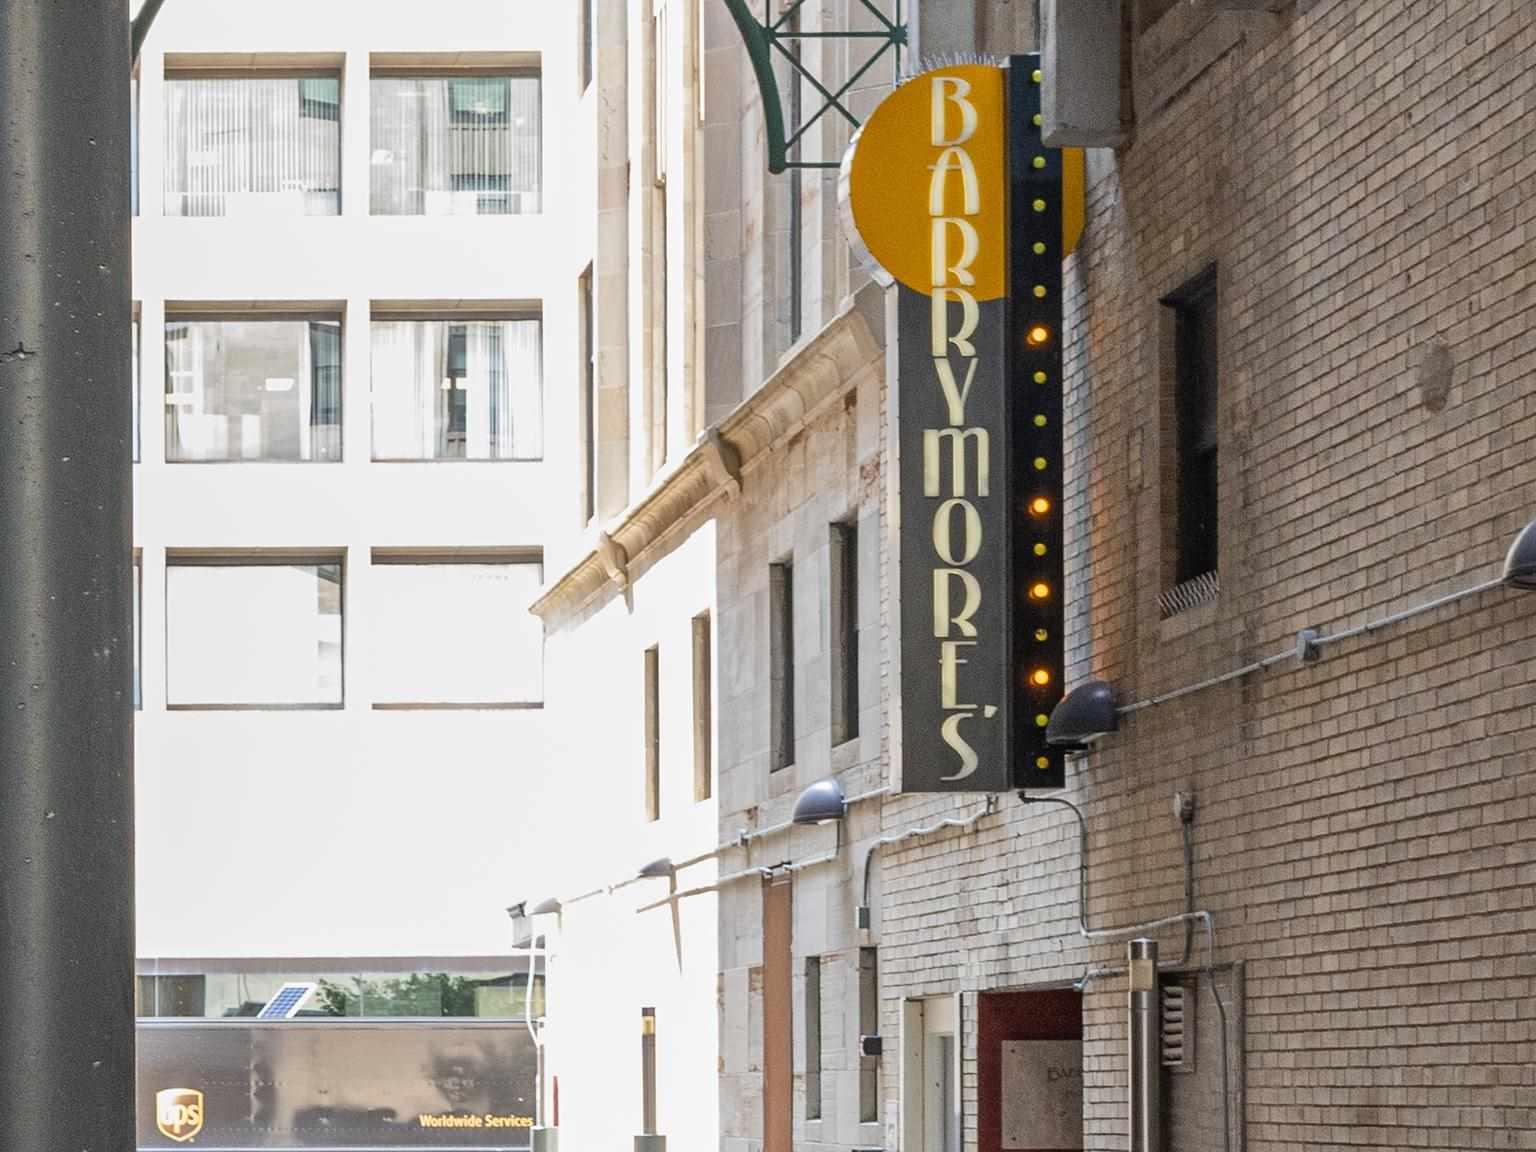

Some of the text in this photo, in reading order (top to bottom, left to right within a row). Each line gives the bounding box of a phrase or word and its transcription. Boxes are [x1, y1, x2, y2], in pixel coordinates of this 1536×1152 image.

[923, 76, 998, 782] BARRYMORE'S
[160, 1104, 200, 1134] ups
[419, 1114, 533, 1127] Worldwide Services
